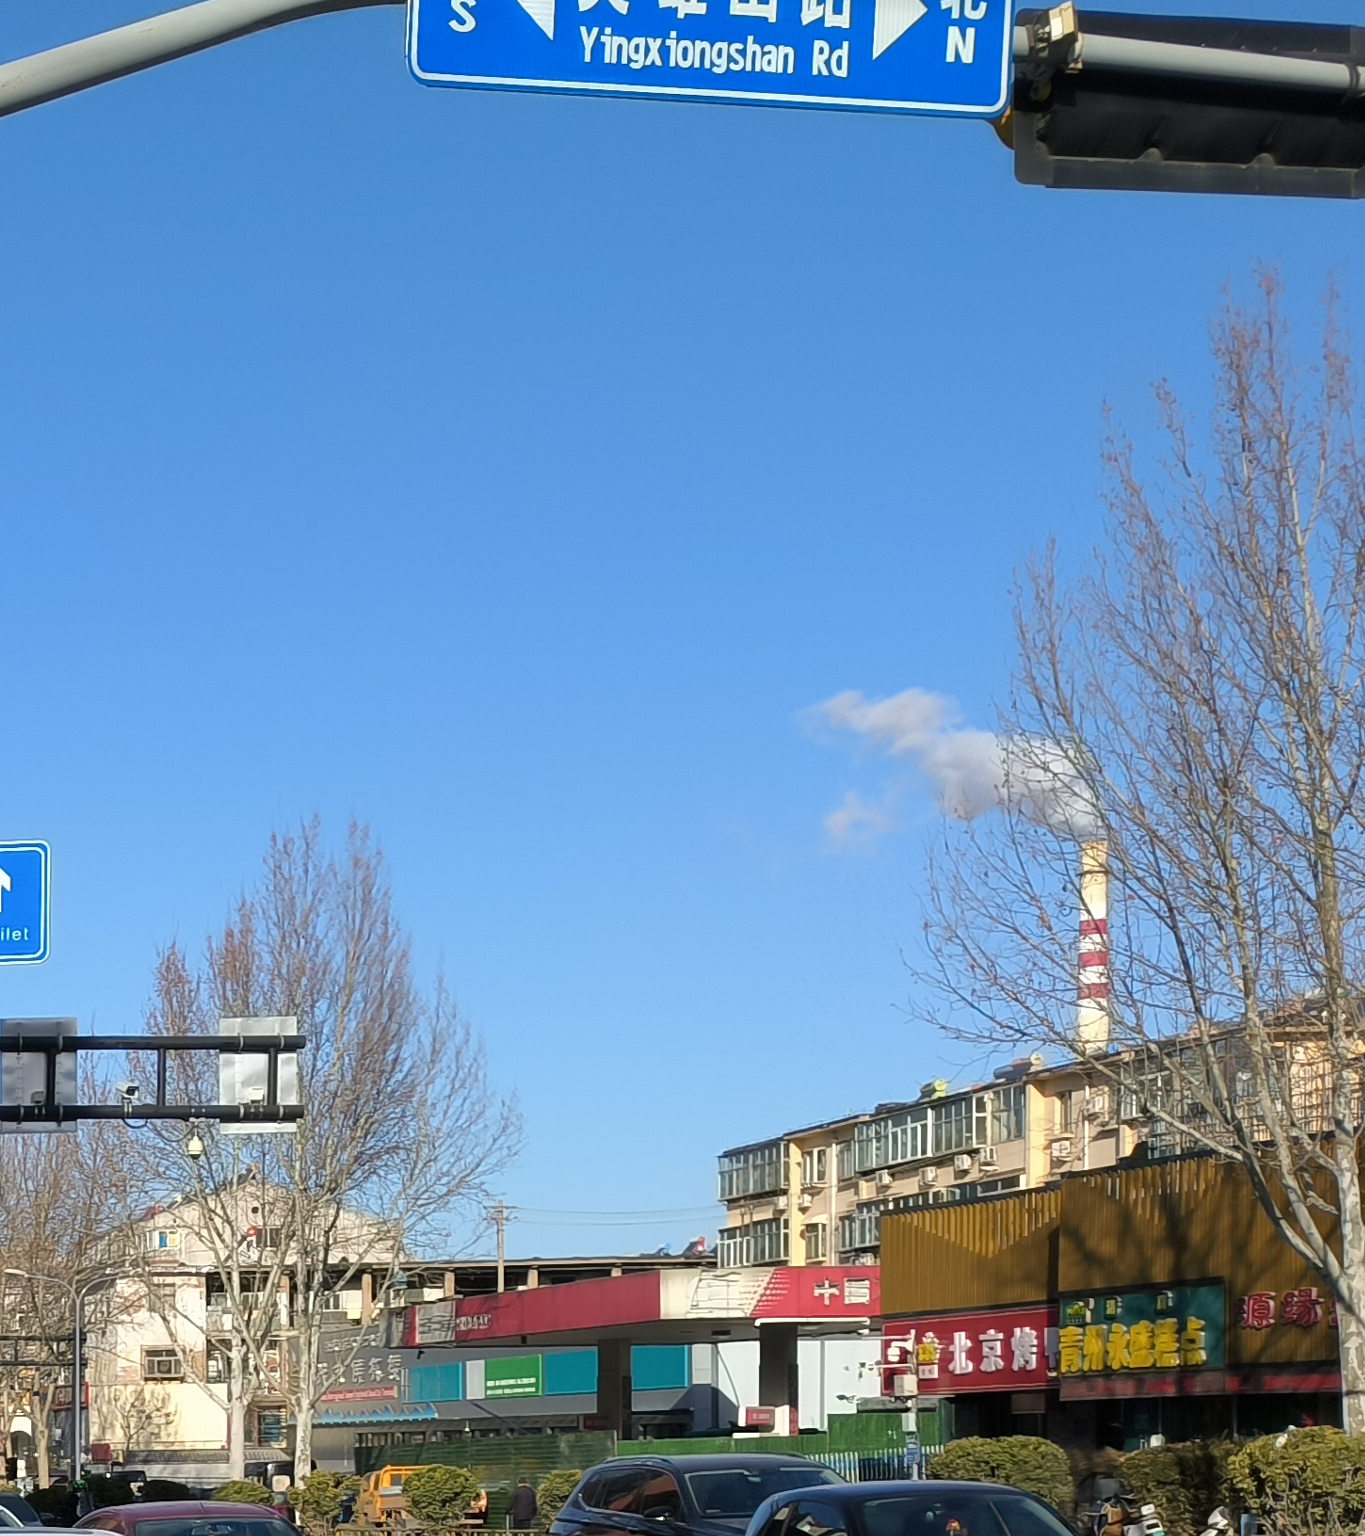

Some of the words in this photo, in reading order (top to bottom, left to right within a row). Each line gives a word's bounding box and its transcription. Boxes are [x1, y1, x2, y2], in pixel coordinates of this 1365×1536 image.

[579, 25, 795, 74] Yingxiongshan
[812, 39, 849, 78] Rd
[945, 25, 976, 64] N
[1237, 1286, 1338, 1331] 源缘
[1059, 1316, 1207, 1374] 青州永盛糕点
